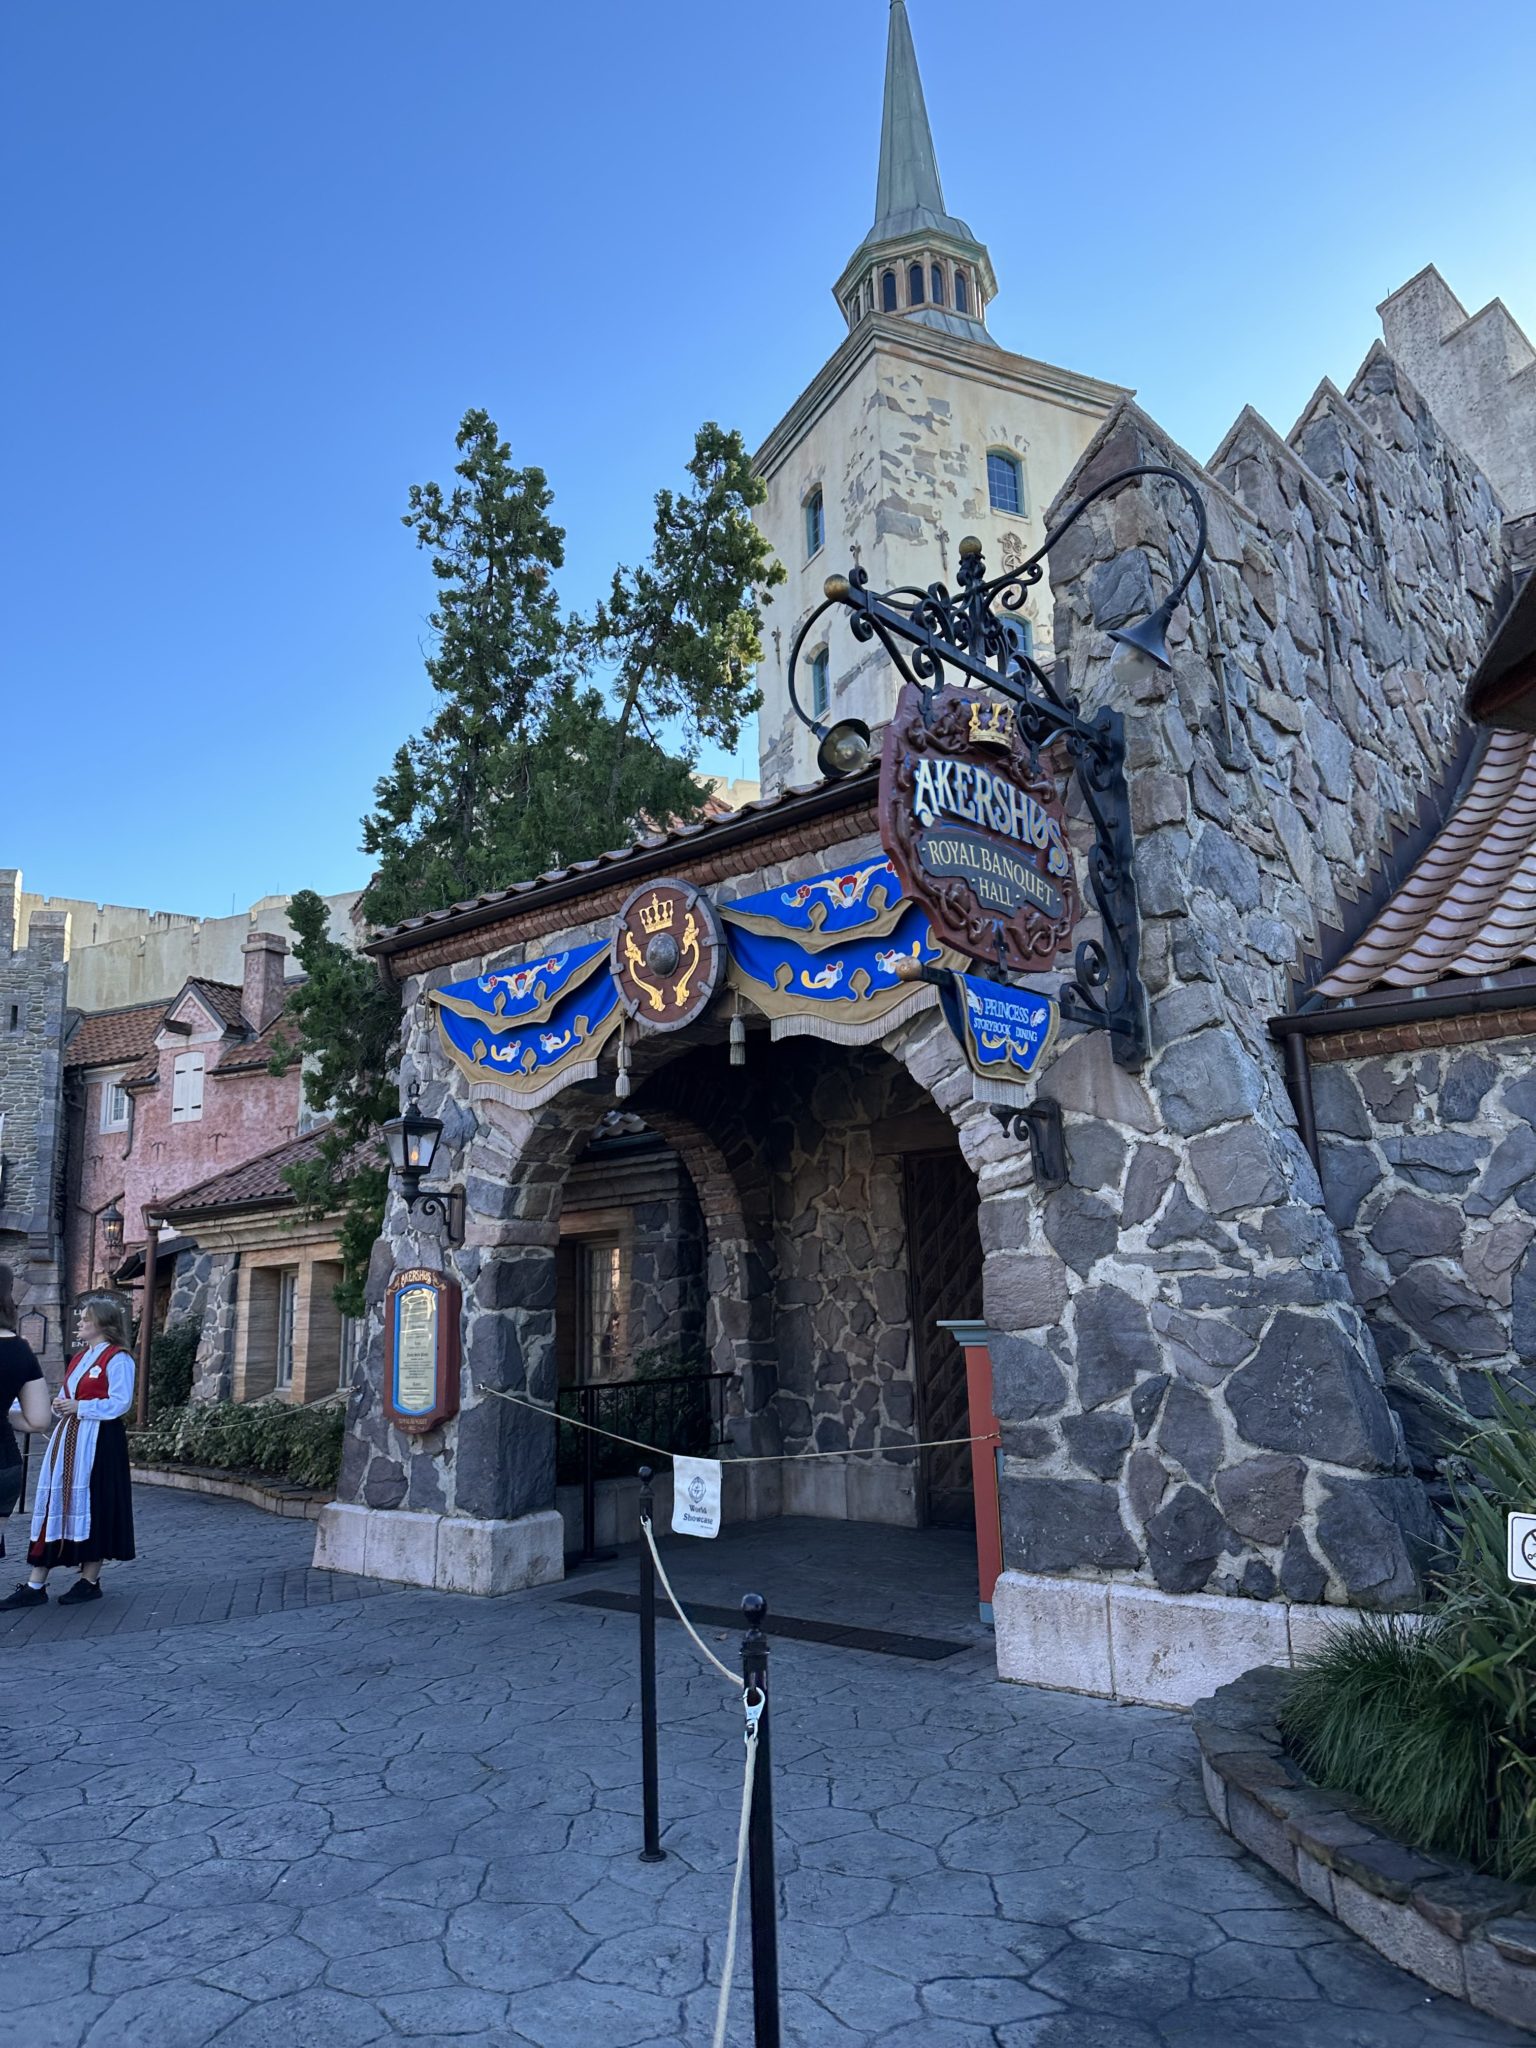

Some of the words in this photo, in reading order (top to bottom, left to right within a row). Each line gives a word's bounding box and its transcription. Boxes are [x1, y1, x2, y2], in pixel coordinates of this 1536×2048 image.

[914, 758, 1069, 877] AKERSHUS
[928, 840, 979, 869] ROYAL
[980, 847, 1053, 906] BANQUET
[979, 877, 1014, 908] HALL
[983, 998, 1029, 1024] PRINCESS
[973, 1017, 1011, 1035] STORYBOOK
[1015, 1026, 1038, 1042] DINING
[401, 1270, 432, 1287] AKERSHUS
[683, 1513, 713, 1524] Showcase
[688, 1504, 707, 1514] World
